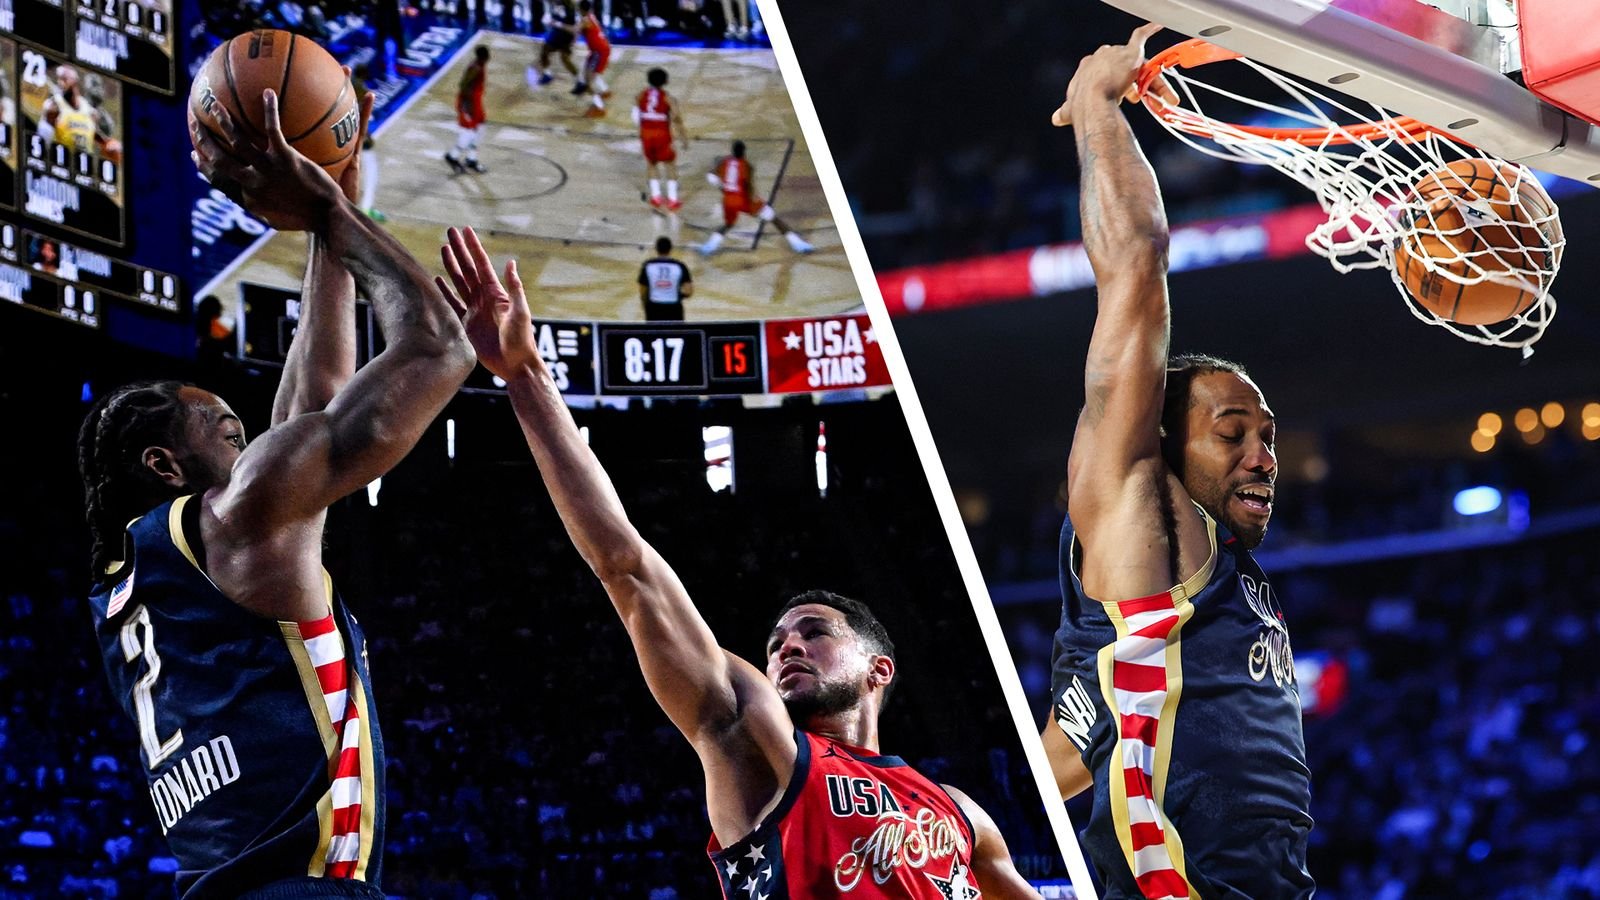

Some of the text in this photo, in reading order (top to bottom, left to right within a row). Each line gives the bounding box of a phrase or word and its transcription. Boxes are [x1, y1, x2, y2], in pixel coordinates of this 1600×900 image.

[23, 51, 47, 87] 23
[624, 337, 685, 383] 8:17
[723, 342, 747, 375] 15
[803, 319, 865, 358] USA
[807, 355, 867, 388] STARS
[120, 604, 184, 770] 2
[150, 734, 241, 836] ONARD
[825, 774, 901, 818] USA
[834, 819, 905, 892] All
